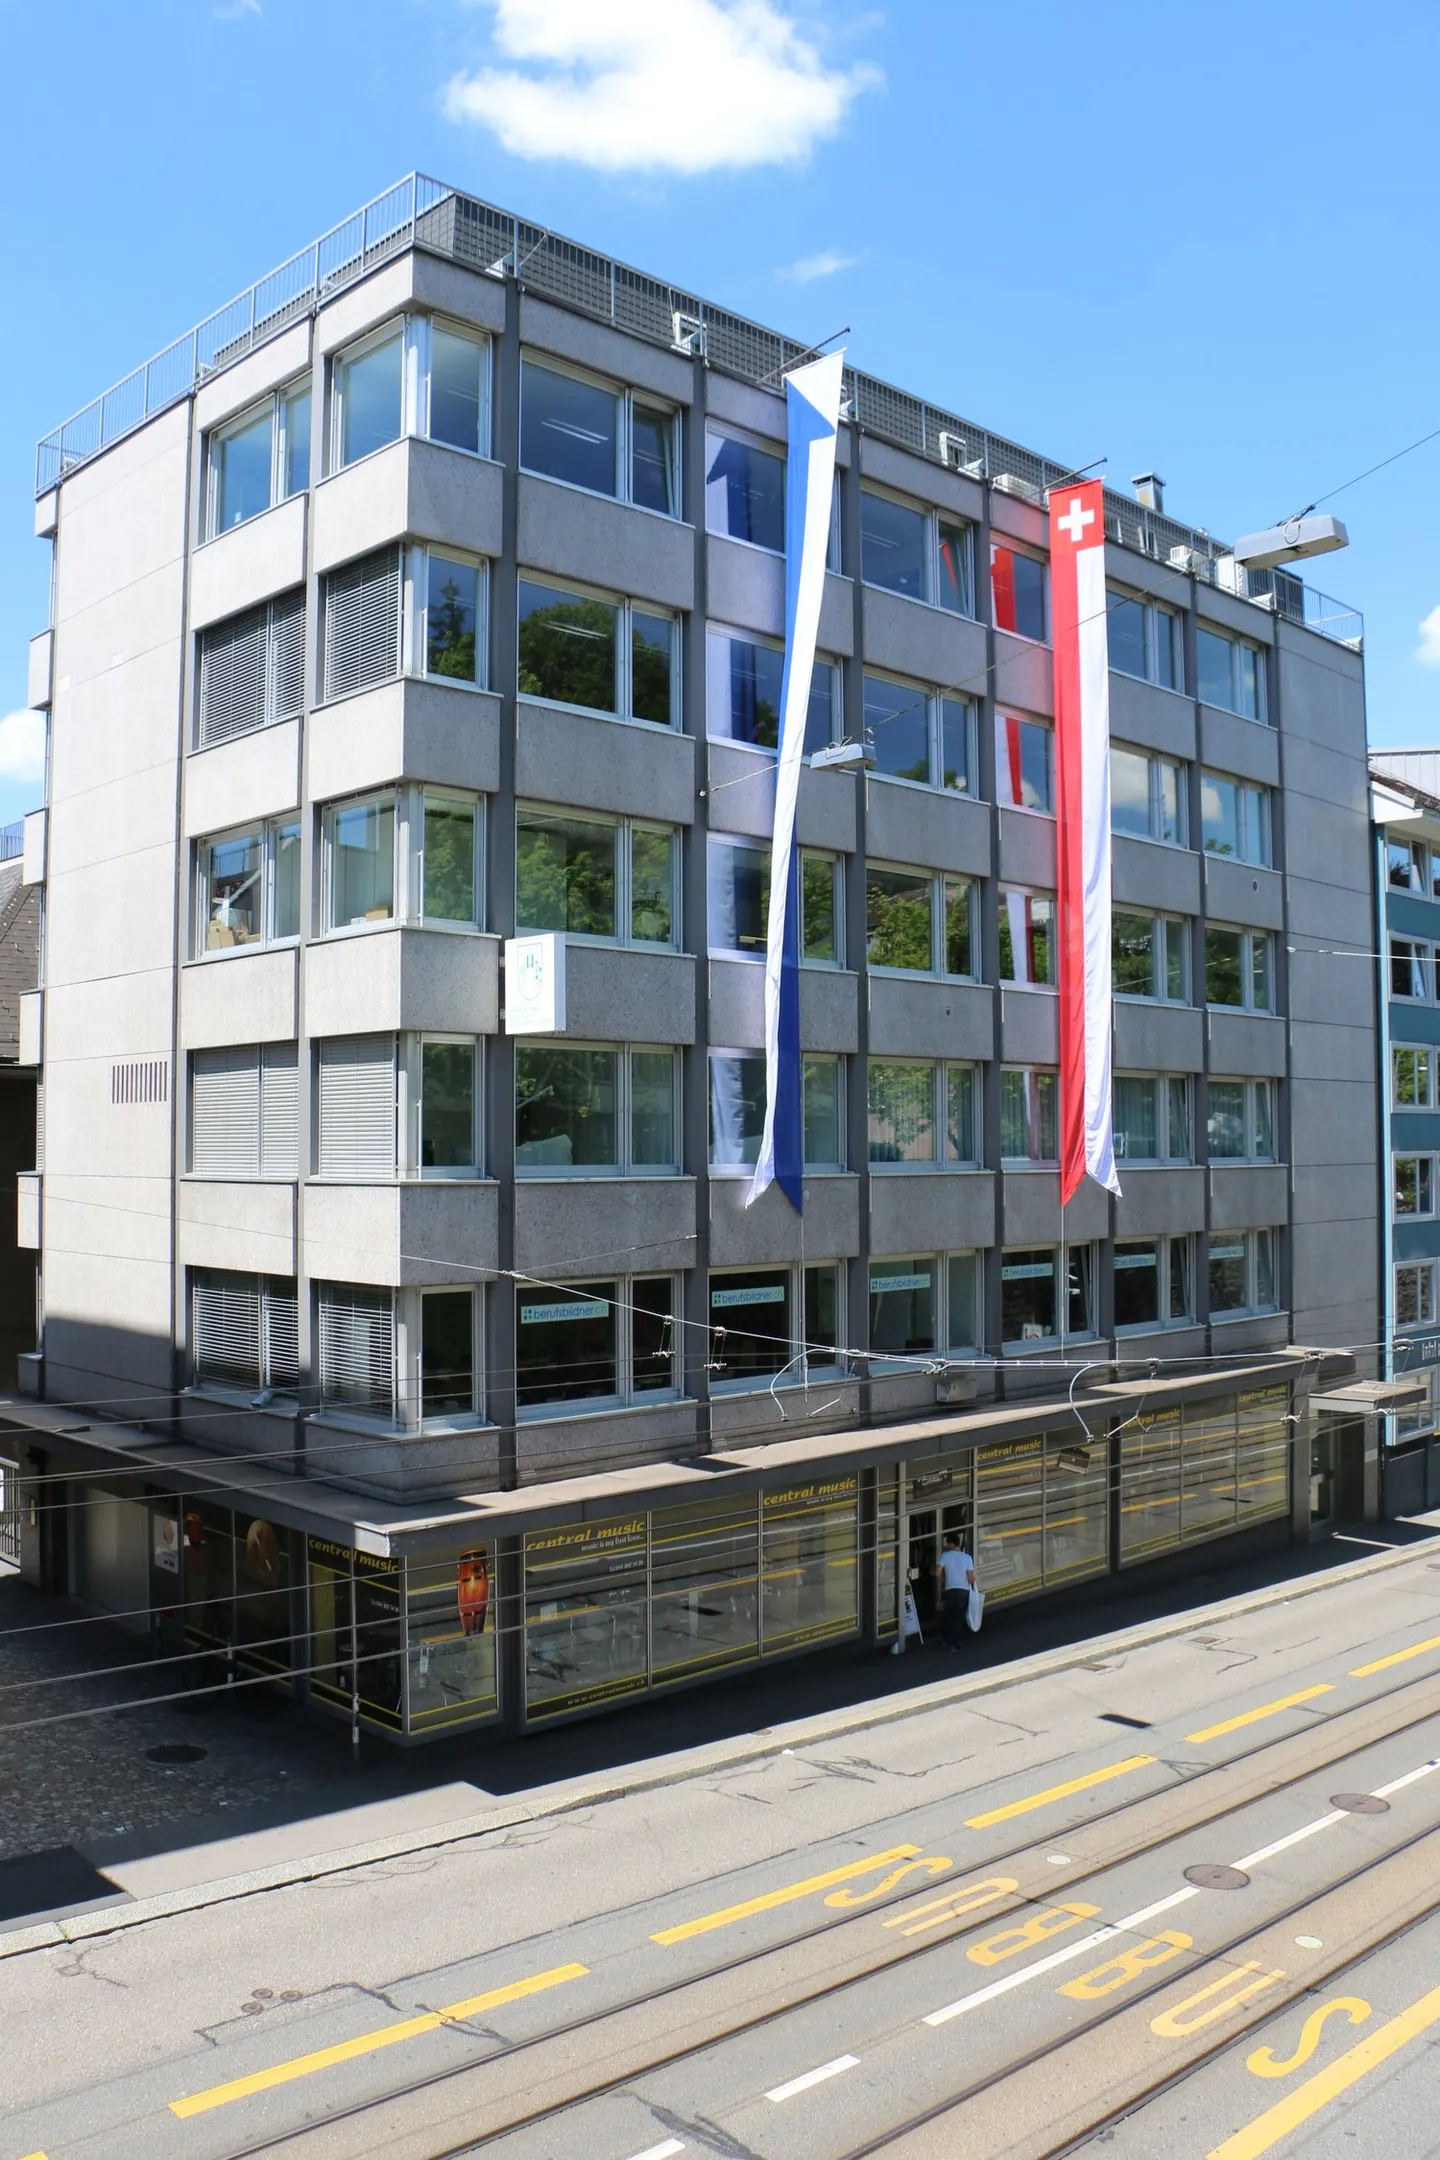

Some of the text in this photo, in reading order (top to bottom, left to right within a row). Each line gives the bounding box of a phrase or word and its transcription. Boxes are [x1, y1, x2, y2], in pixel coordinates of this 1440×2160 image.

[1123, 1413, 1154, 1429] entral
[1157, 1408, 1181, 1420] music
[977, 1445, 1012, 1461] central
[1015, 1440, 1041, 1452] music
[763, 1485, 814, 1505] central
[819, 1478, 856, 1494] music
[526, 1520, 645, 1551] central music
[308, 1538, 399, 1573] central music
[823, 1855, 1103, 1965] BUS
[1054, 1929, 1372, 2079] BUS
